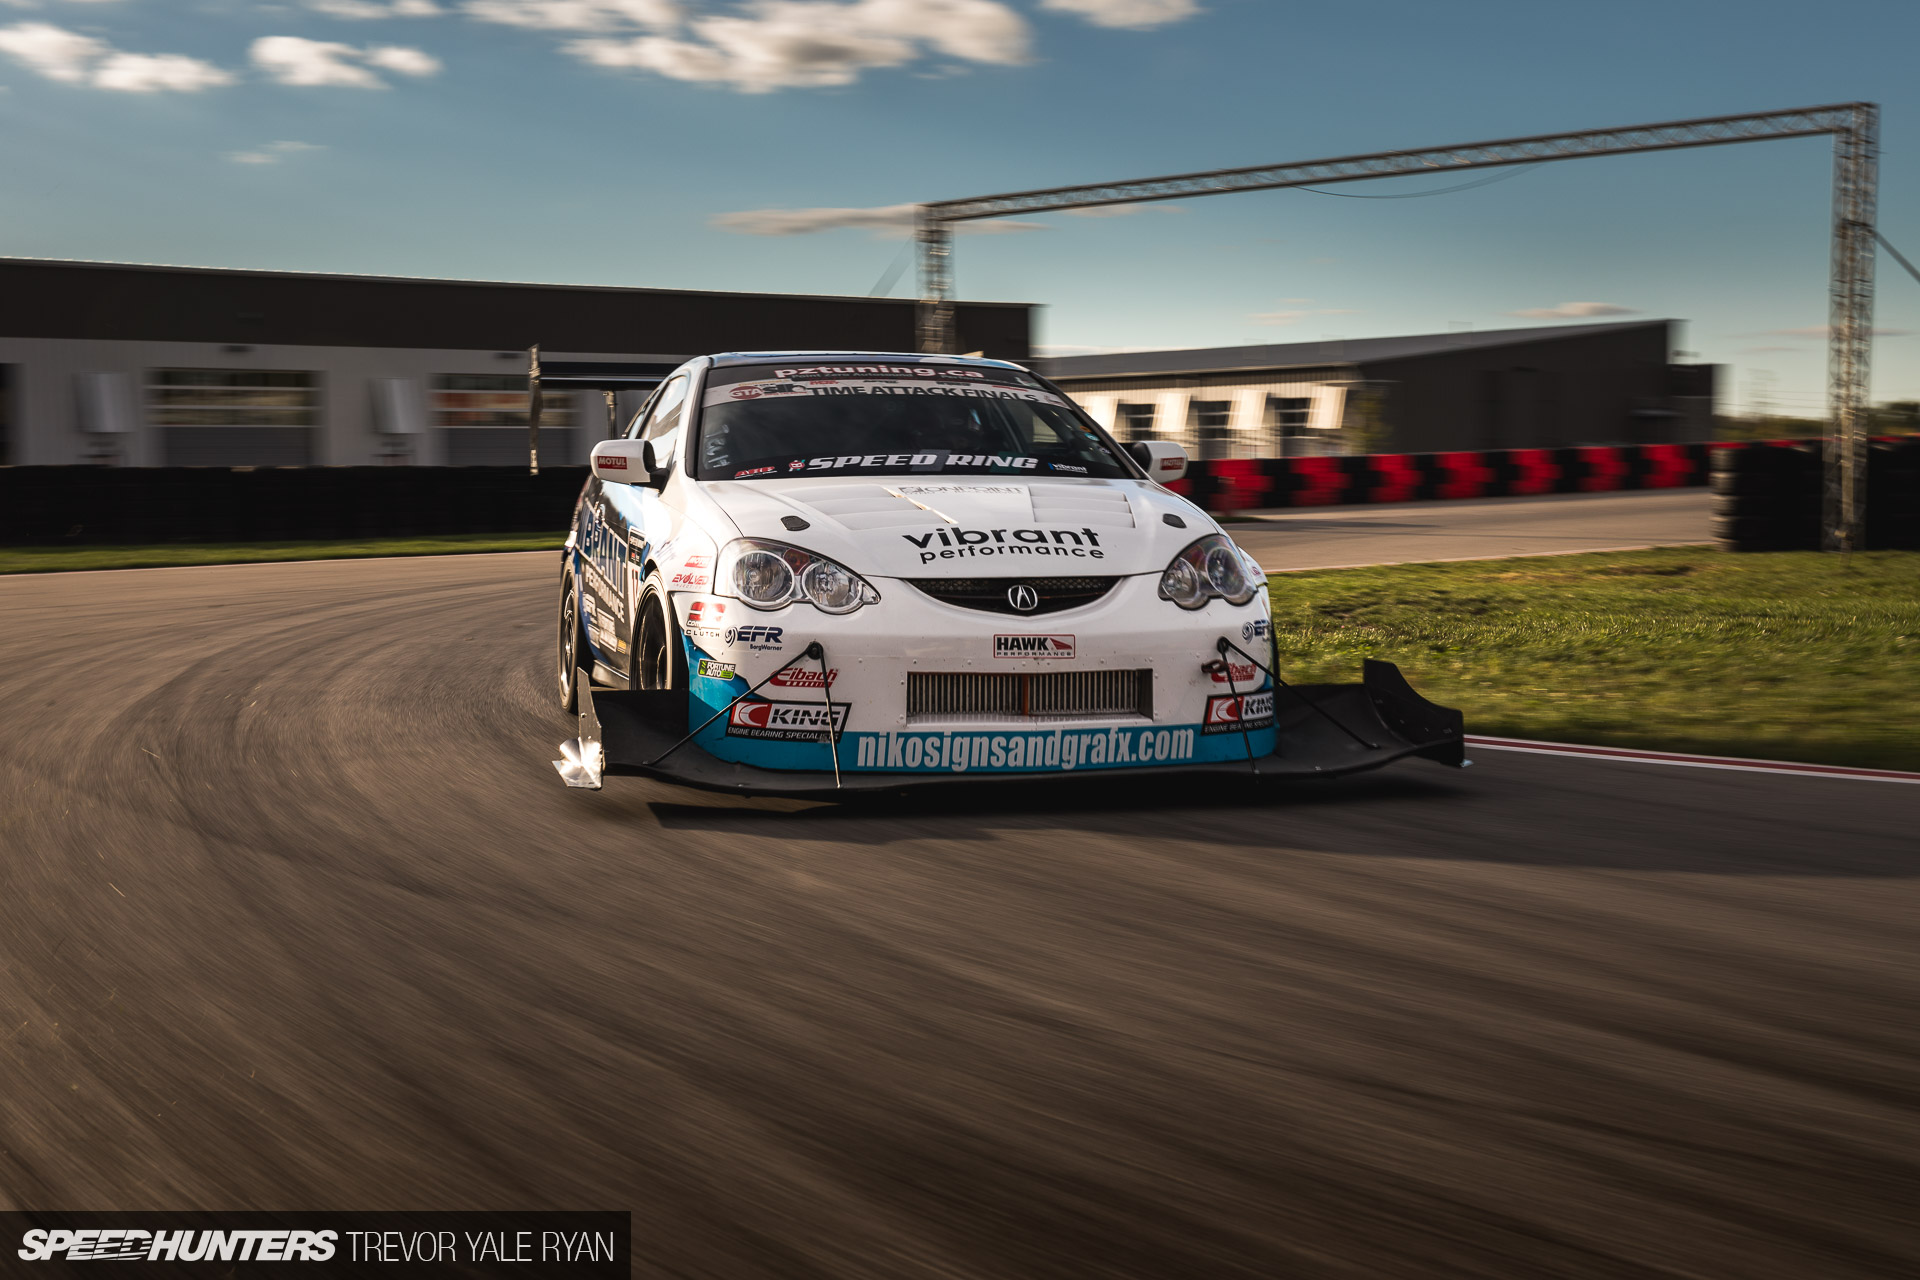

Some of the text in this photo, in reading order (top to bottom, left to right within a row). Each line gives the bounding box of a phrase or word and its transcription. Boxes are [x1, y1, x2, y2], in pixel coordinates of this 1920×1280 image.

[774, 365, 984, 380] pztuning.ca
[730, 388, 762, 397] GTA
[807, 386, 865, 396] TIME
[871, 386, 960, 397] ATTACK
[961, 388, 1039, 402] FINALS
[598, 457, 626, 466] MOTUL
[806, 454, 1039, 470] SPEED RING
[901, 527, 1100, 549] vibrant
[919, 544, 1105, 565] performance
[672, 573, 709, 586] EVOLVED
[686, 629, 720, 638] CLUTCH
[737, 625, 783, 643] EFR
[750, 643, 783, 652] BorgWarner
[996, 637, 1049, 651] HAWK
[705, 668, 722, 678] AUTO
[707, 661, 735, 672] FORTUNE
[769, 667, 838, 688] Eibach
[771, 708, 840, 727] KING
[728, 726, 749, 737] ENGINE
[751, 728, 784, 739] BEARING
[857, 728, 1194, 772] nikosignsandgrafx.com
